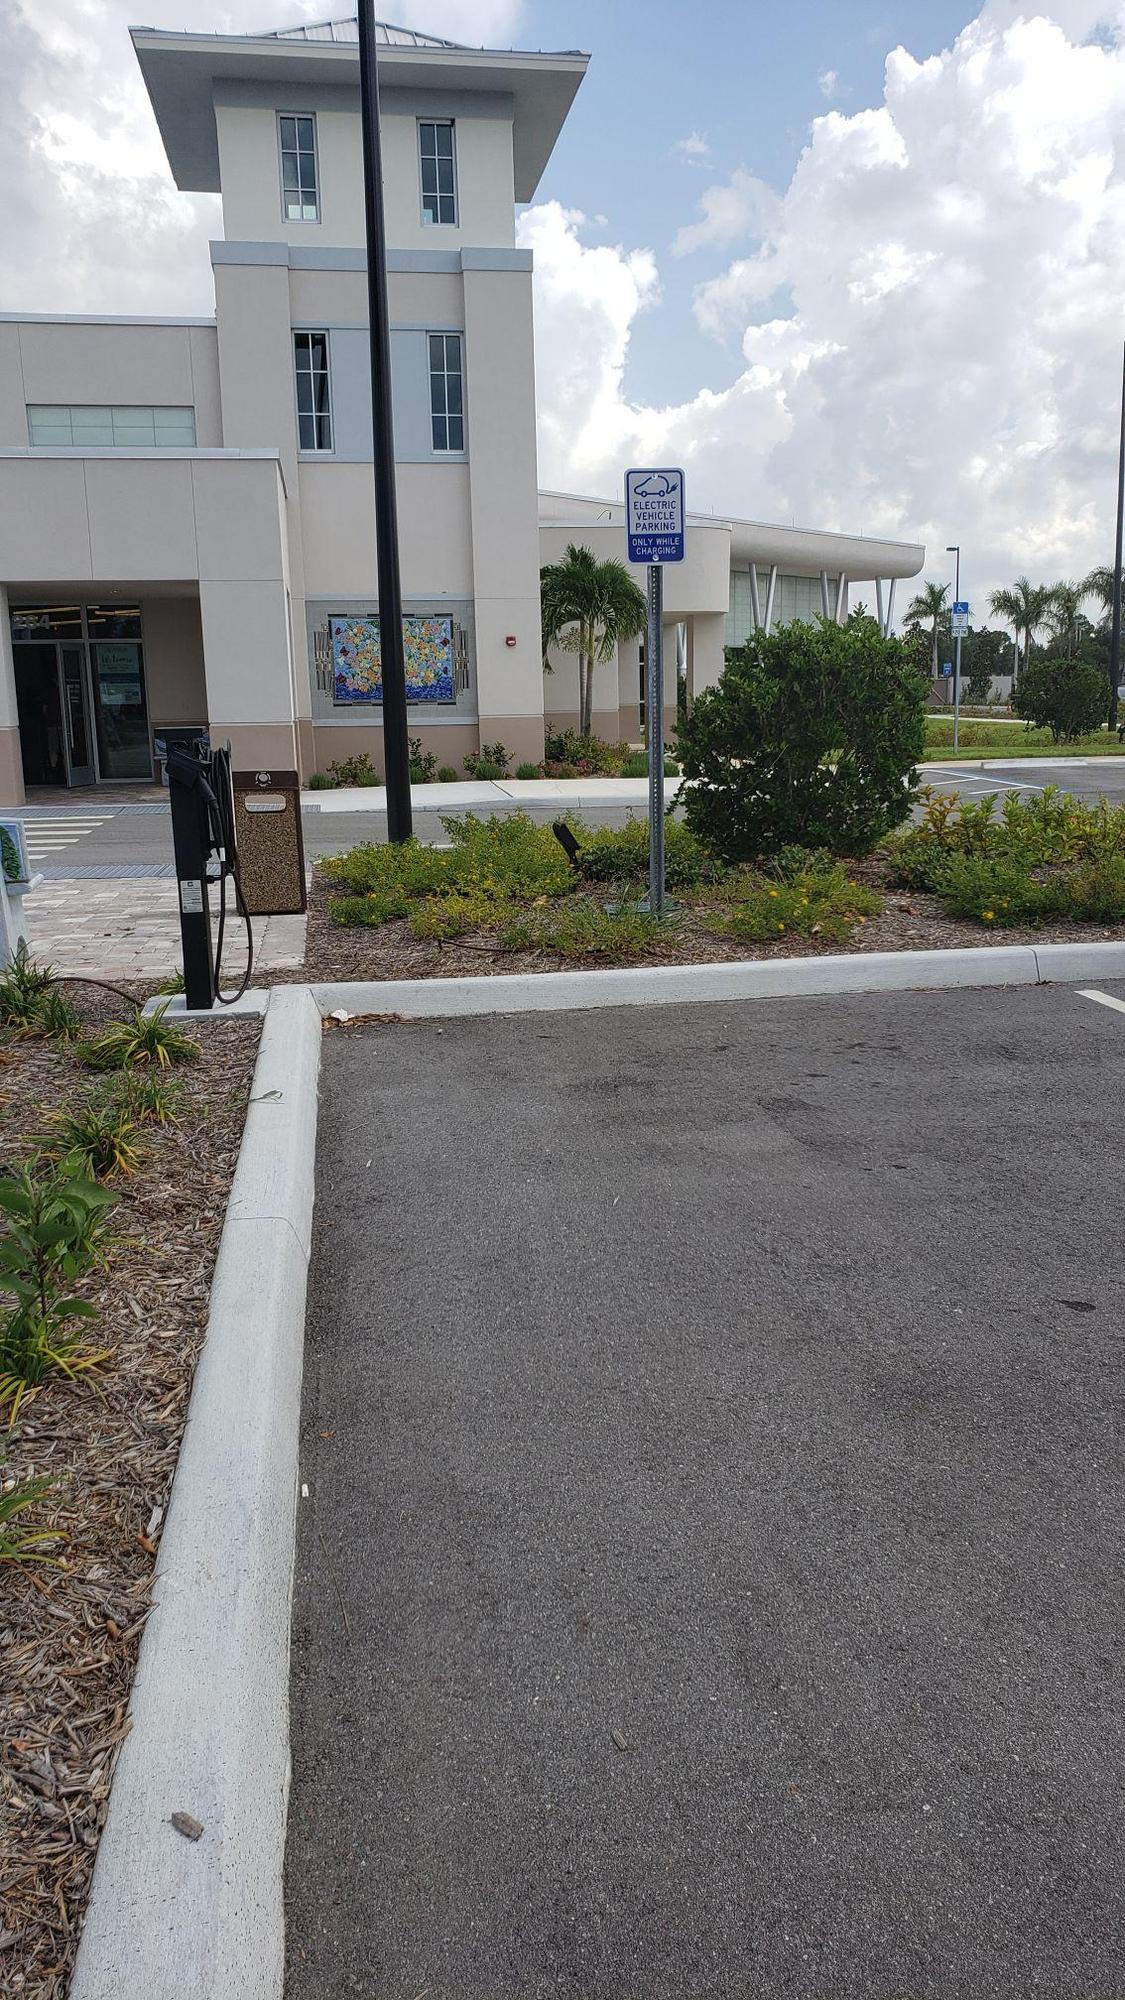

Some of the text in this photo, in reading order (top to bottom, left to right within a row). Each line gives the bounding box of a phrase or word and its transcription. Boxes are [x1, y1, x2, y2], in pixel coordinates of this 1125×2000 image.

[634, 501, 676, 510] ELECTRIC
[636, 511, 675, 521] VEHICLE
[635, 522, 675, 531] PARKING
[632, 537, 680, 546] ONLY WHILE
[636, 546, 676, 555] CHARGING
